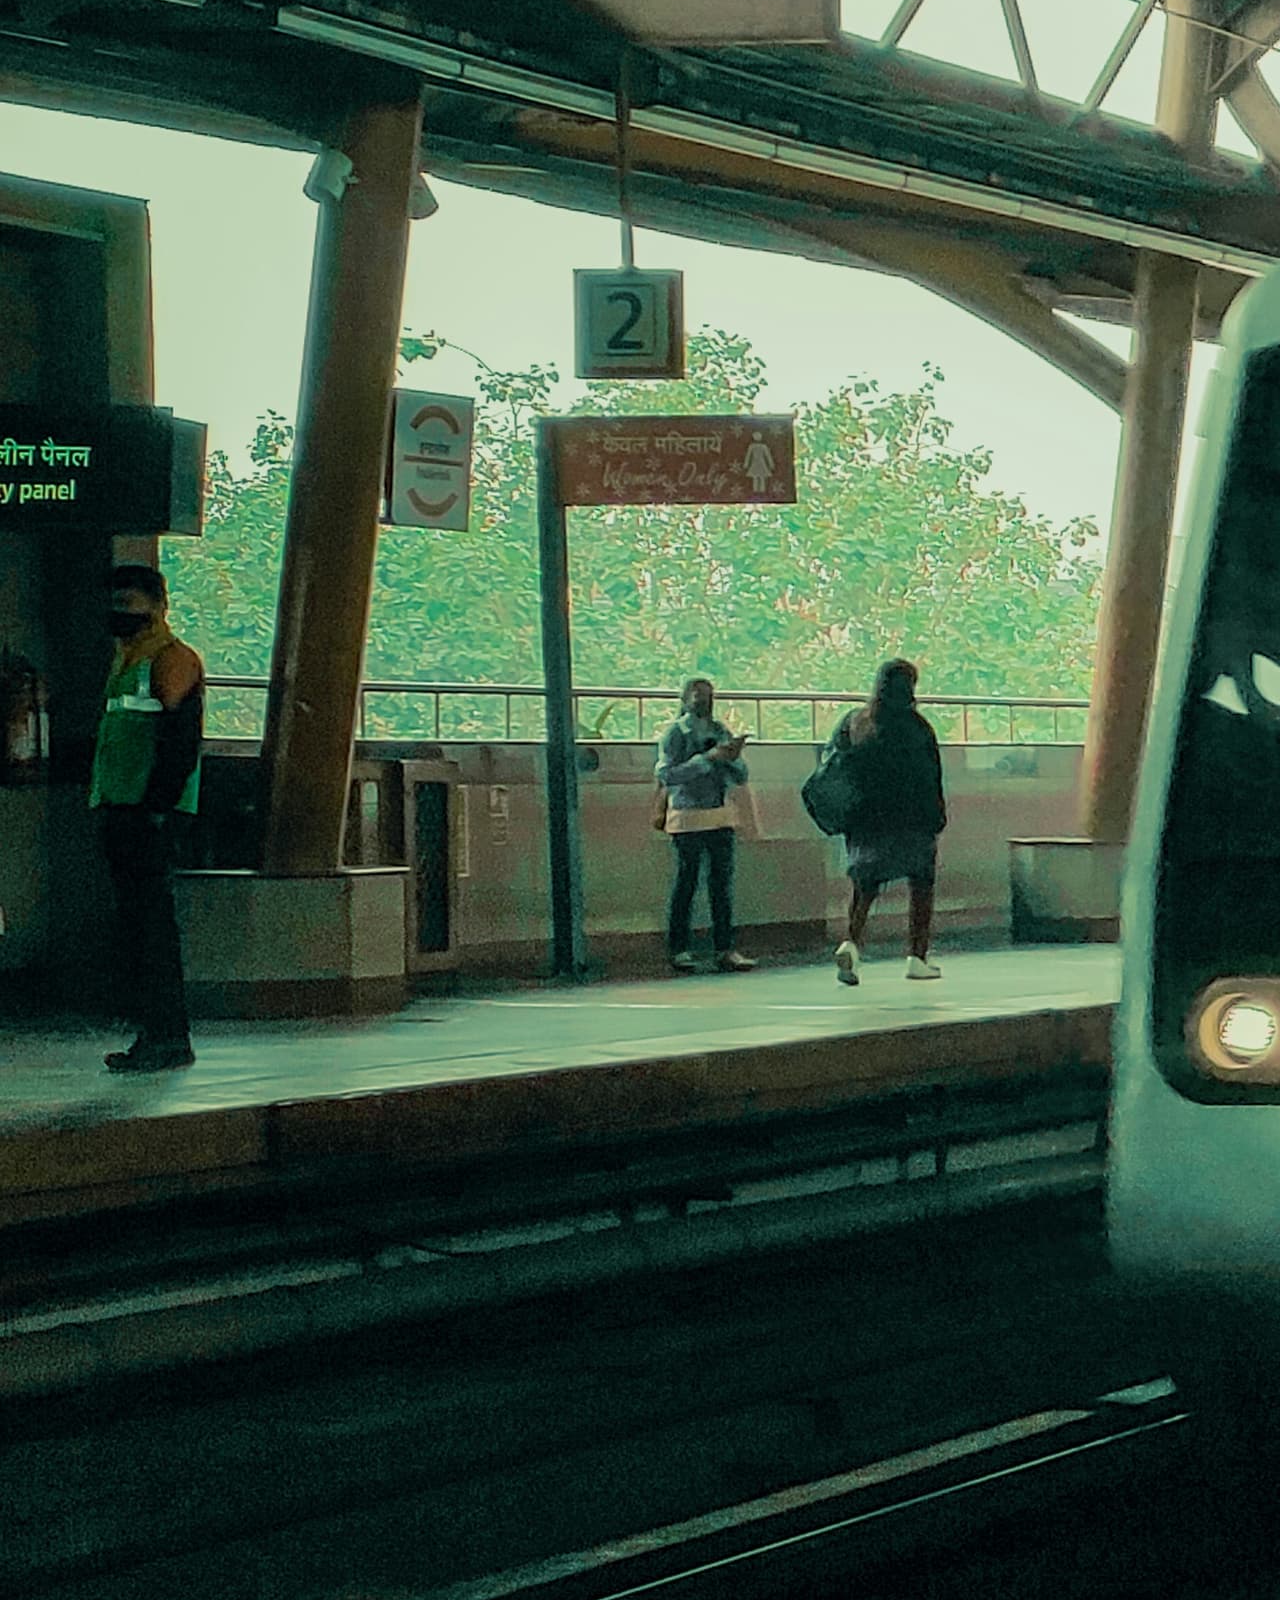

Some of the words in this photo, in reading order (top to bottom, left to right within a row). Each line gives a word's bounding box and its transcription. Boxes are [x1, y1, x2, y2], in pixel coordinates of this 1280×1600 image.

[607, 291, 643, 350] 2
[40, 436, 93, 467] पैनल
[19, 479, 76, 504] panel
[678, 462, 729, 494] Only
